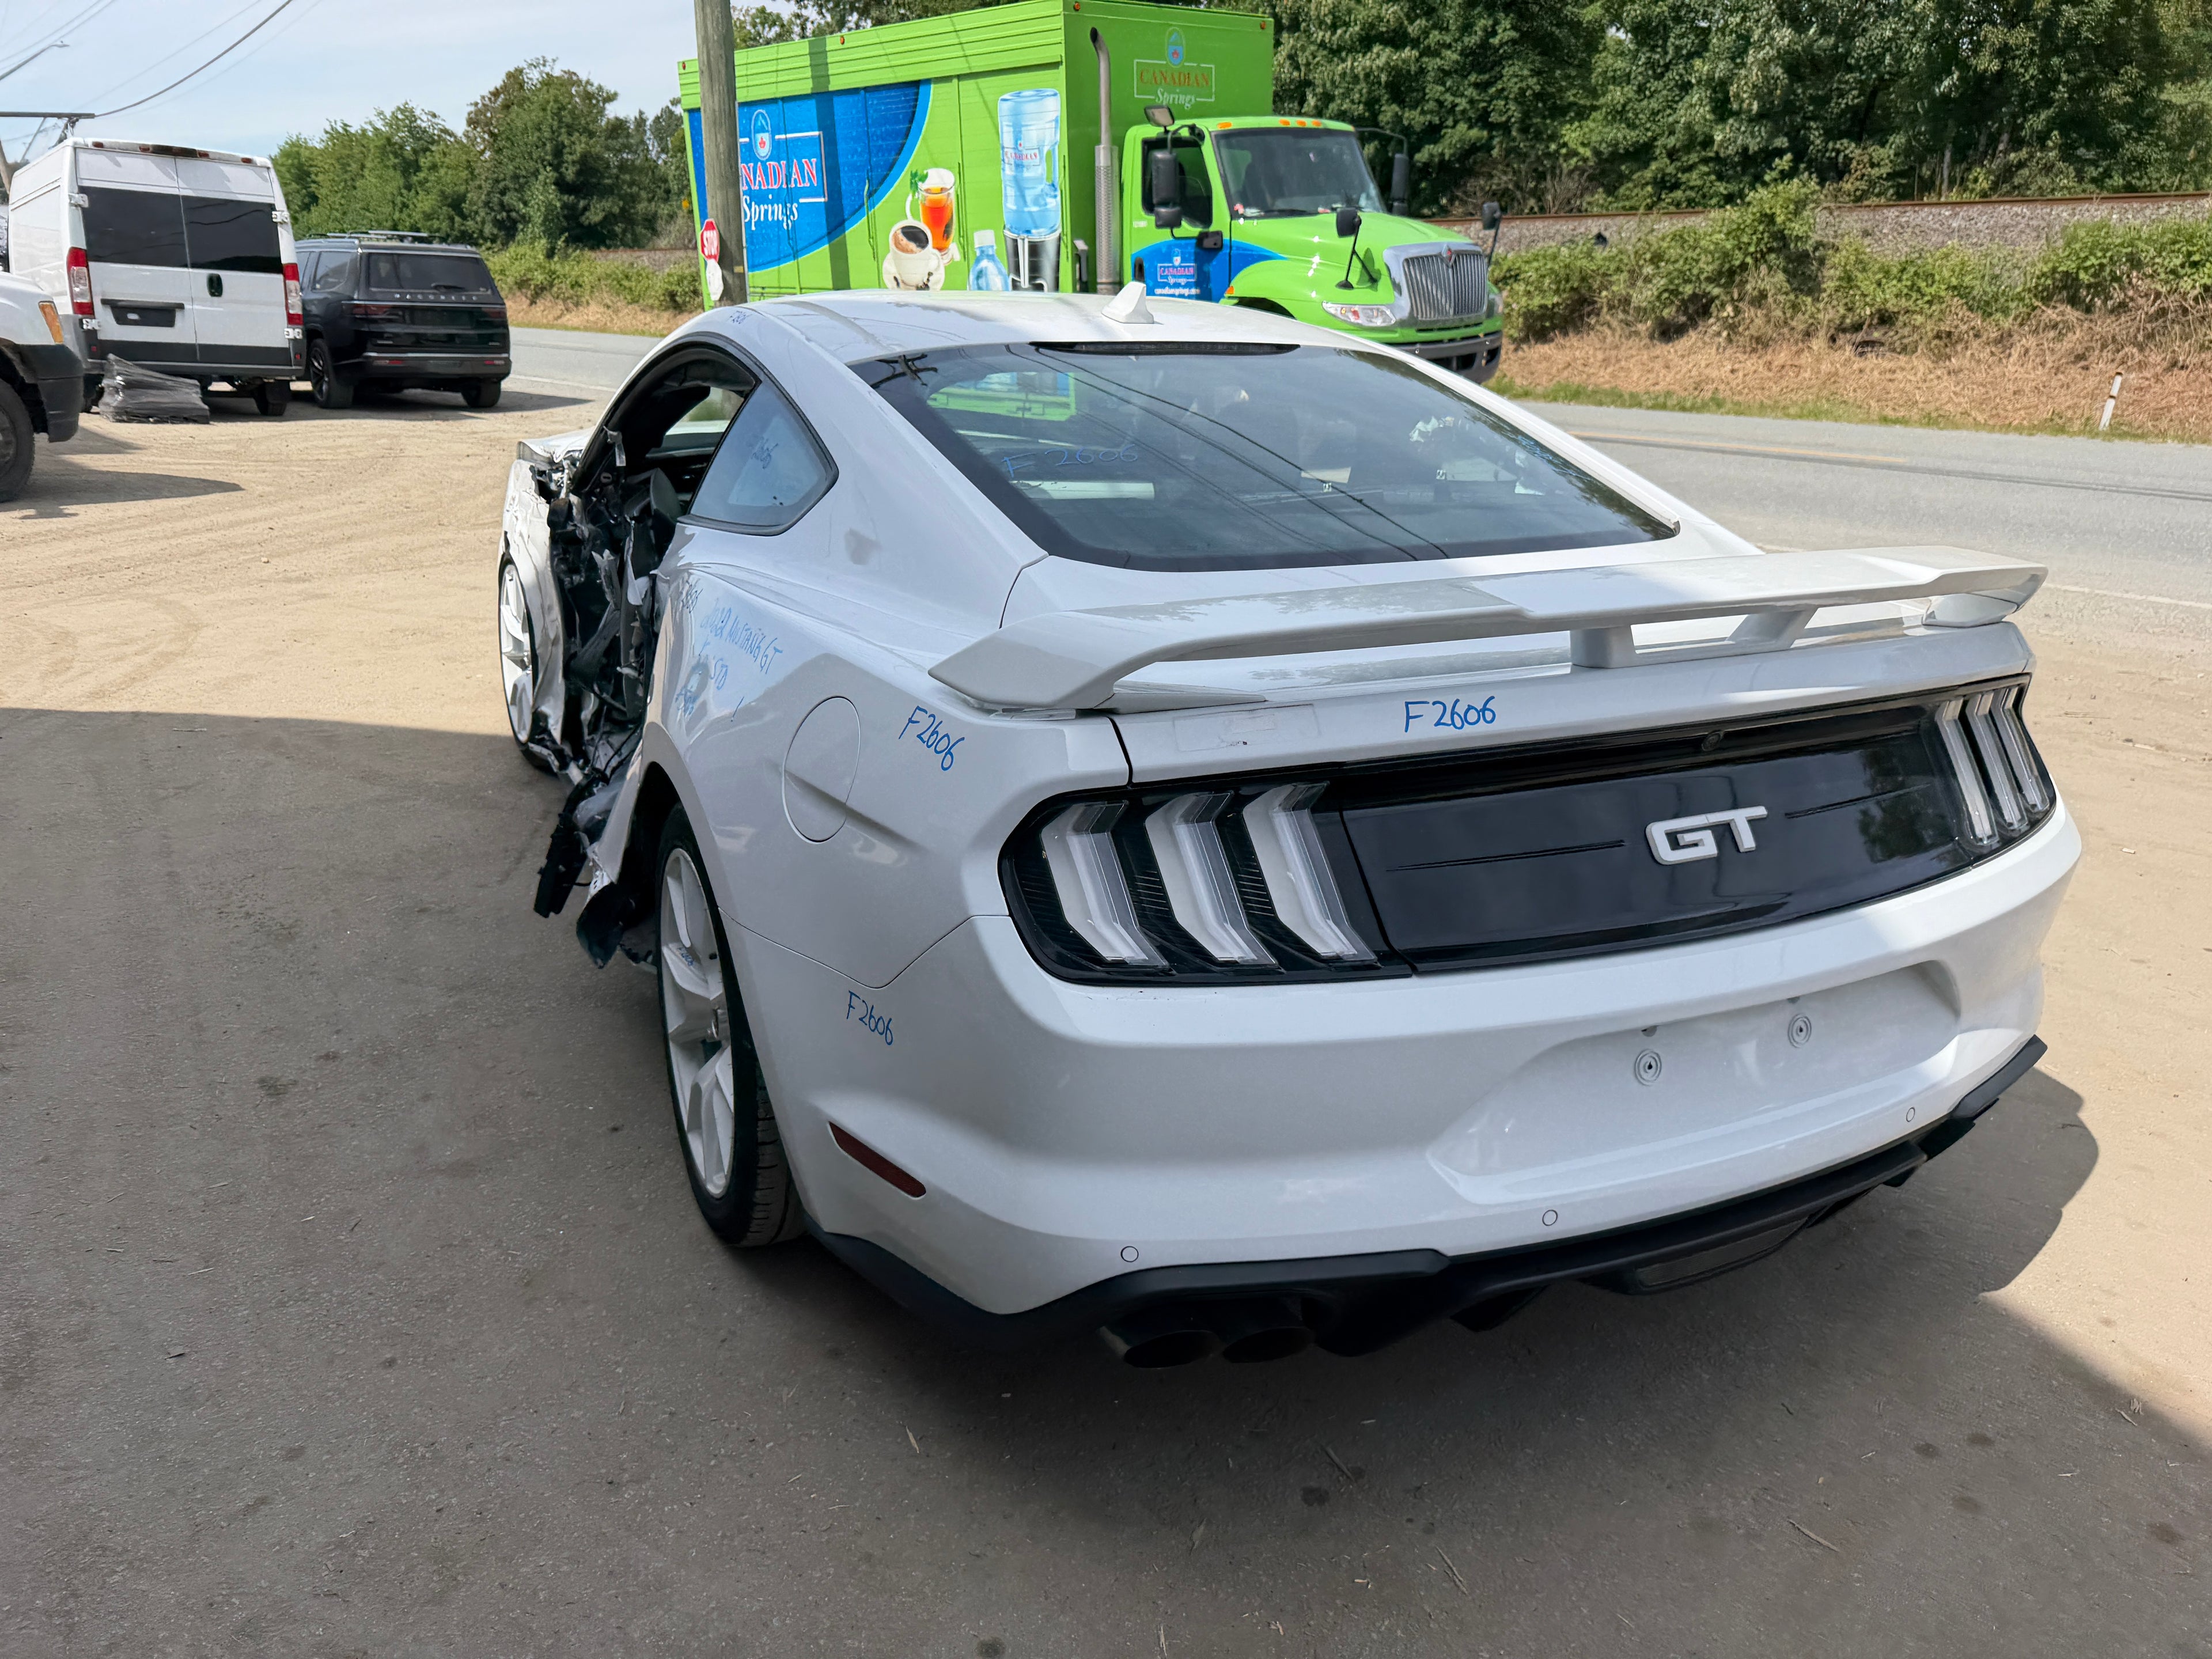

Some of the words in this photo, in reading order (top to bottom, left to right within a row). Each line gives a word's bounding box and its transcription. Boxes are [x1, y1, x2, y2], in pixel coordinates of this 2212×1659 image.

[1139, 69, 1210, 88] CANADIAN
[1156, 88, 1196, 109] Springs
[741, 158, 817, 190] NADIAN
[742, 194, 798, 231] Springs
[1159, 267, 1195, 275] CANADIAN
[1002, 444, 1138, 478] F2606
[1404, 696, 1496, 733] F2606
[899, 706, 965, 771] F2606
[1646, 805, 1768, 865] GT
[846, 990, 893, 1046] F2606
